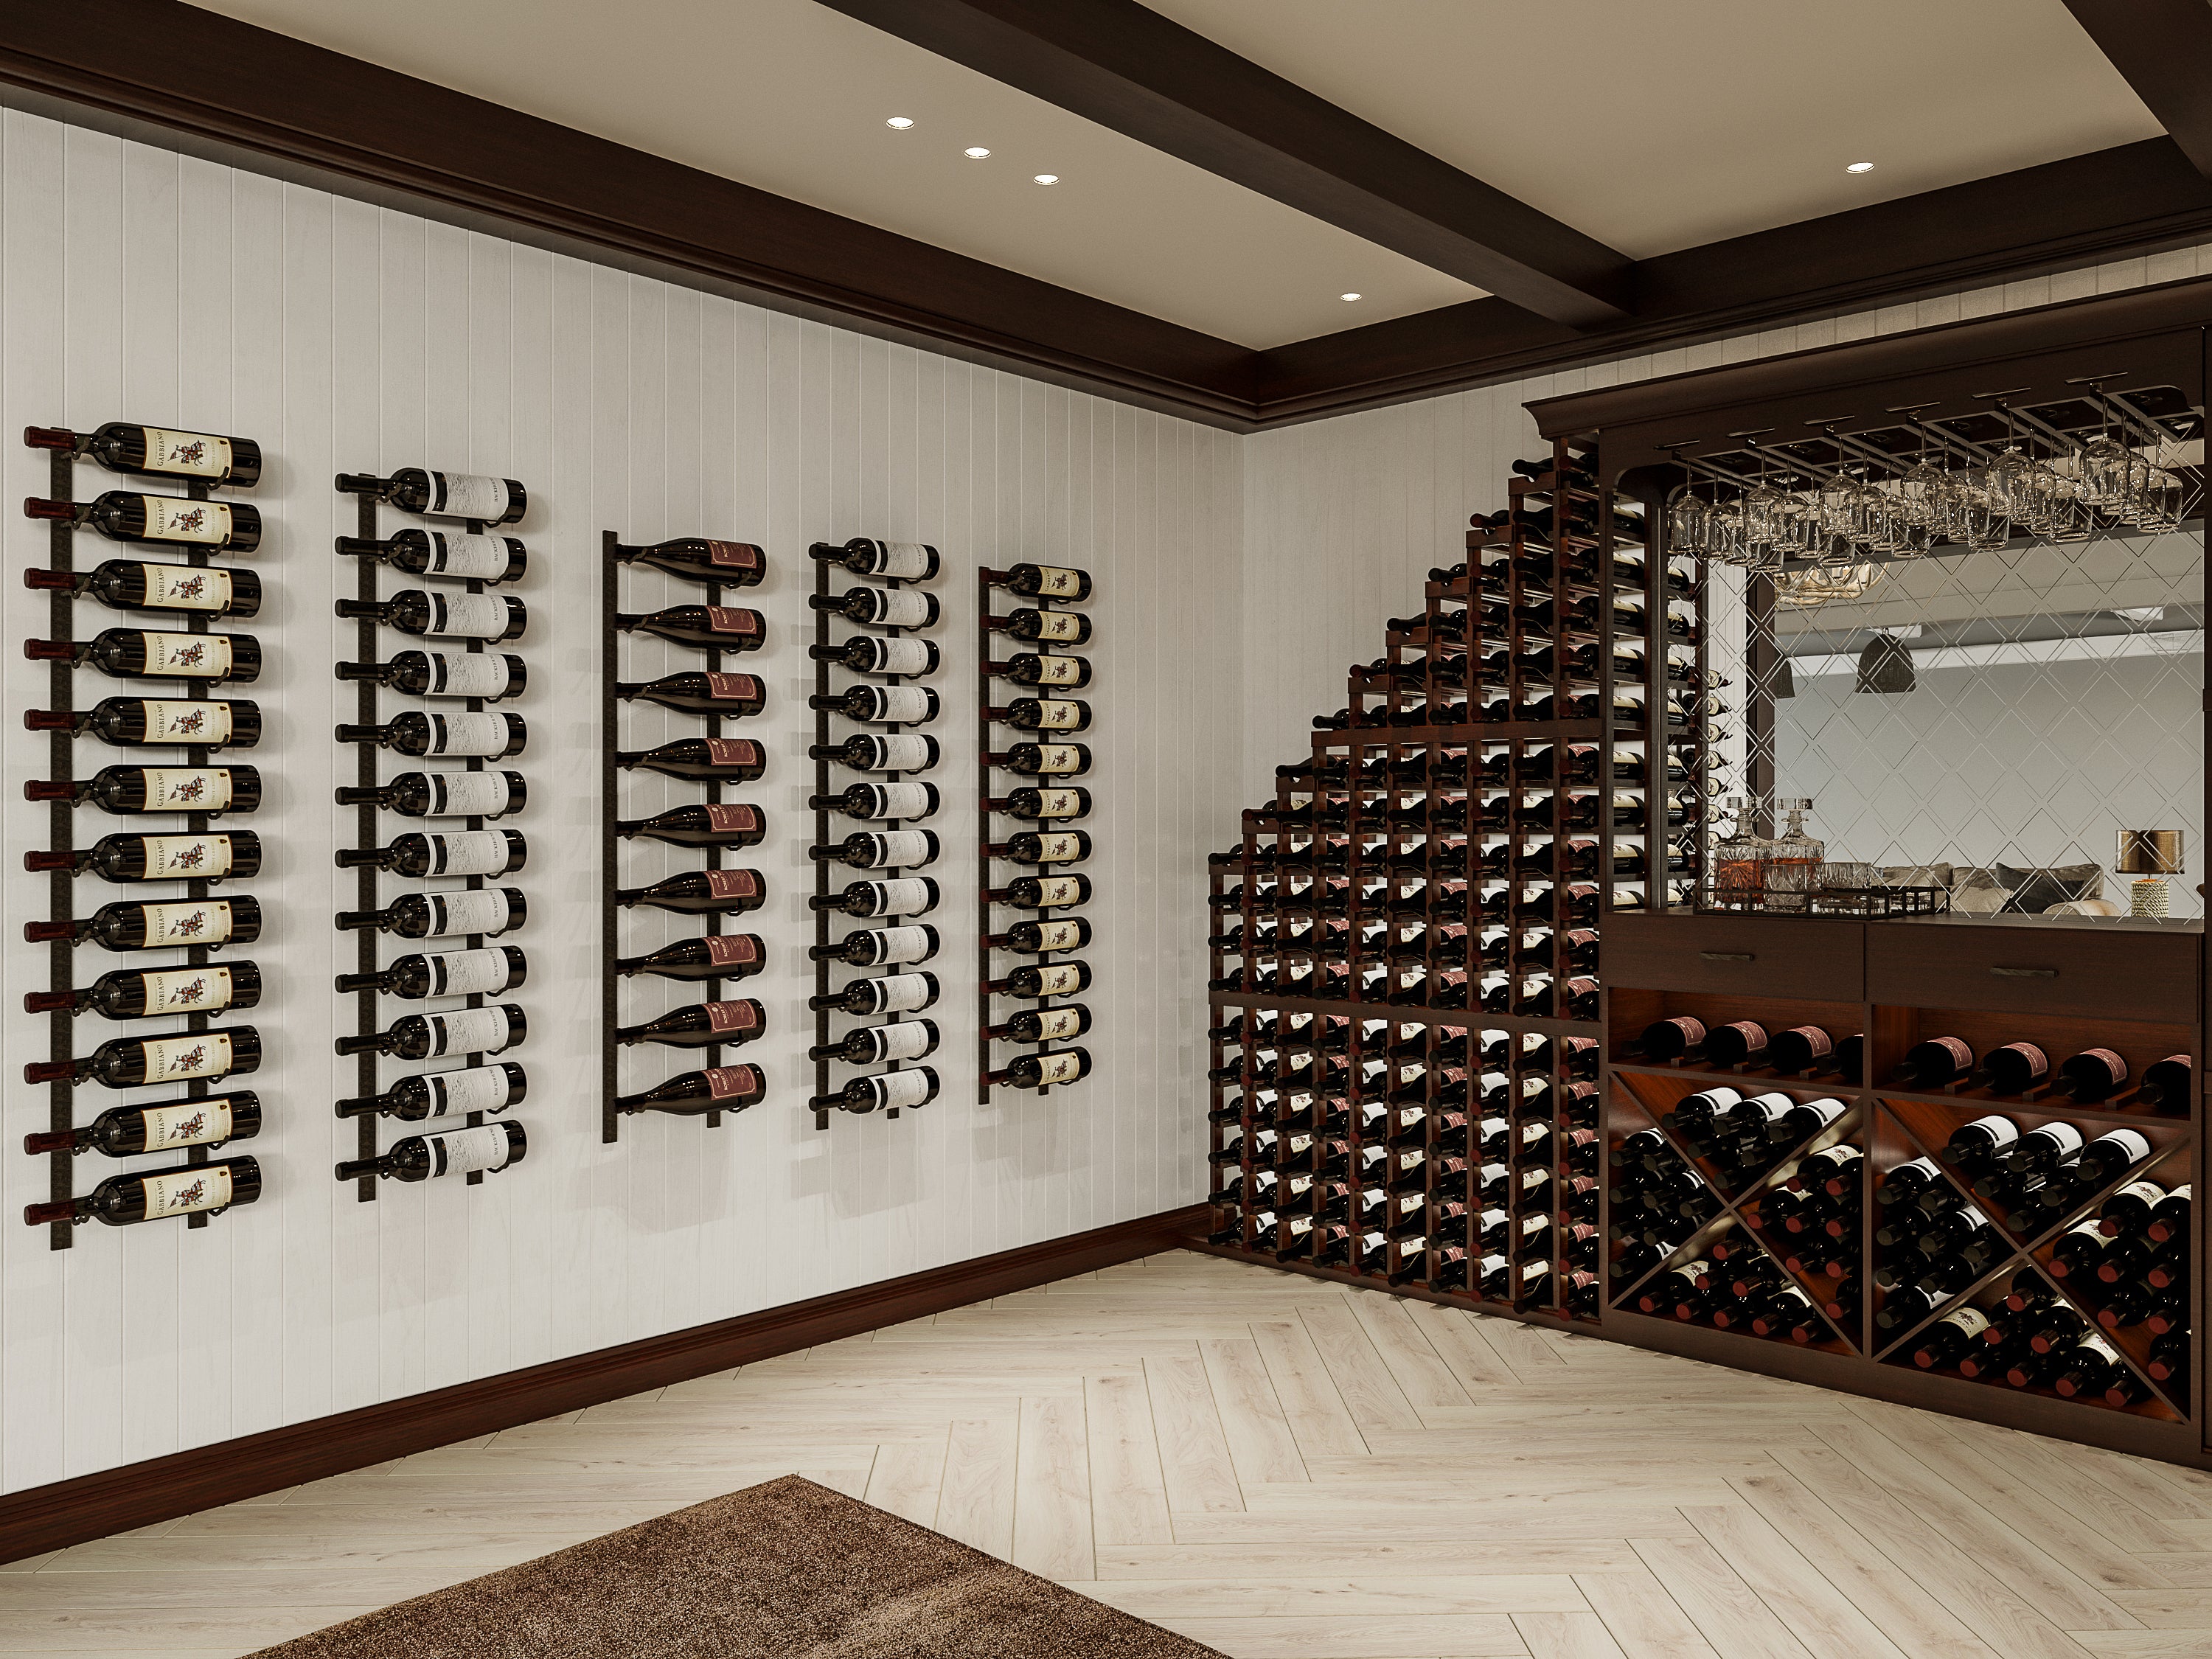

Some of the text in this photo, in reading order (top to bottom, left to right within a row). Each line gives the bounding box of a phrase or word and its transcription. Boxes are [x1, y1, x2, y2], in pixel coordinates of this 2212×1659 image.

[156, 431, 165, 466] GABBIANO
[156, 500, 165, 535] GABBIANO
[156, 568, 165, 603] GABBIANO
[156, 636, 165, 671] GABBIANO
[156, 703, 165, 739] GABBIANO
[156, 773, 165, 807] GABBIANO
[156, 841, 165, 874] GABBIANO
[156, 908, 165, 942] GABBIANO
[156, 976, 165, 1011] GABBIANO
[156, 1044, 165, 1079] GABBIANO
[156, 1113, 165, 1147] GABBIANO
[156, 1180, 165, 1215] GABBIANO
